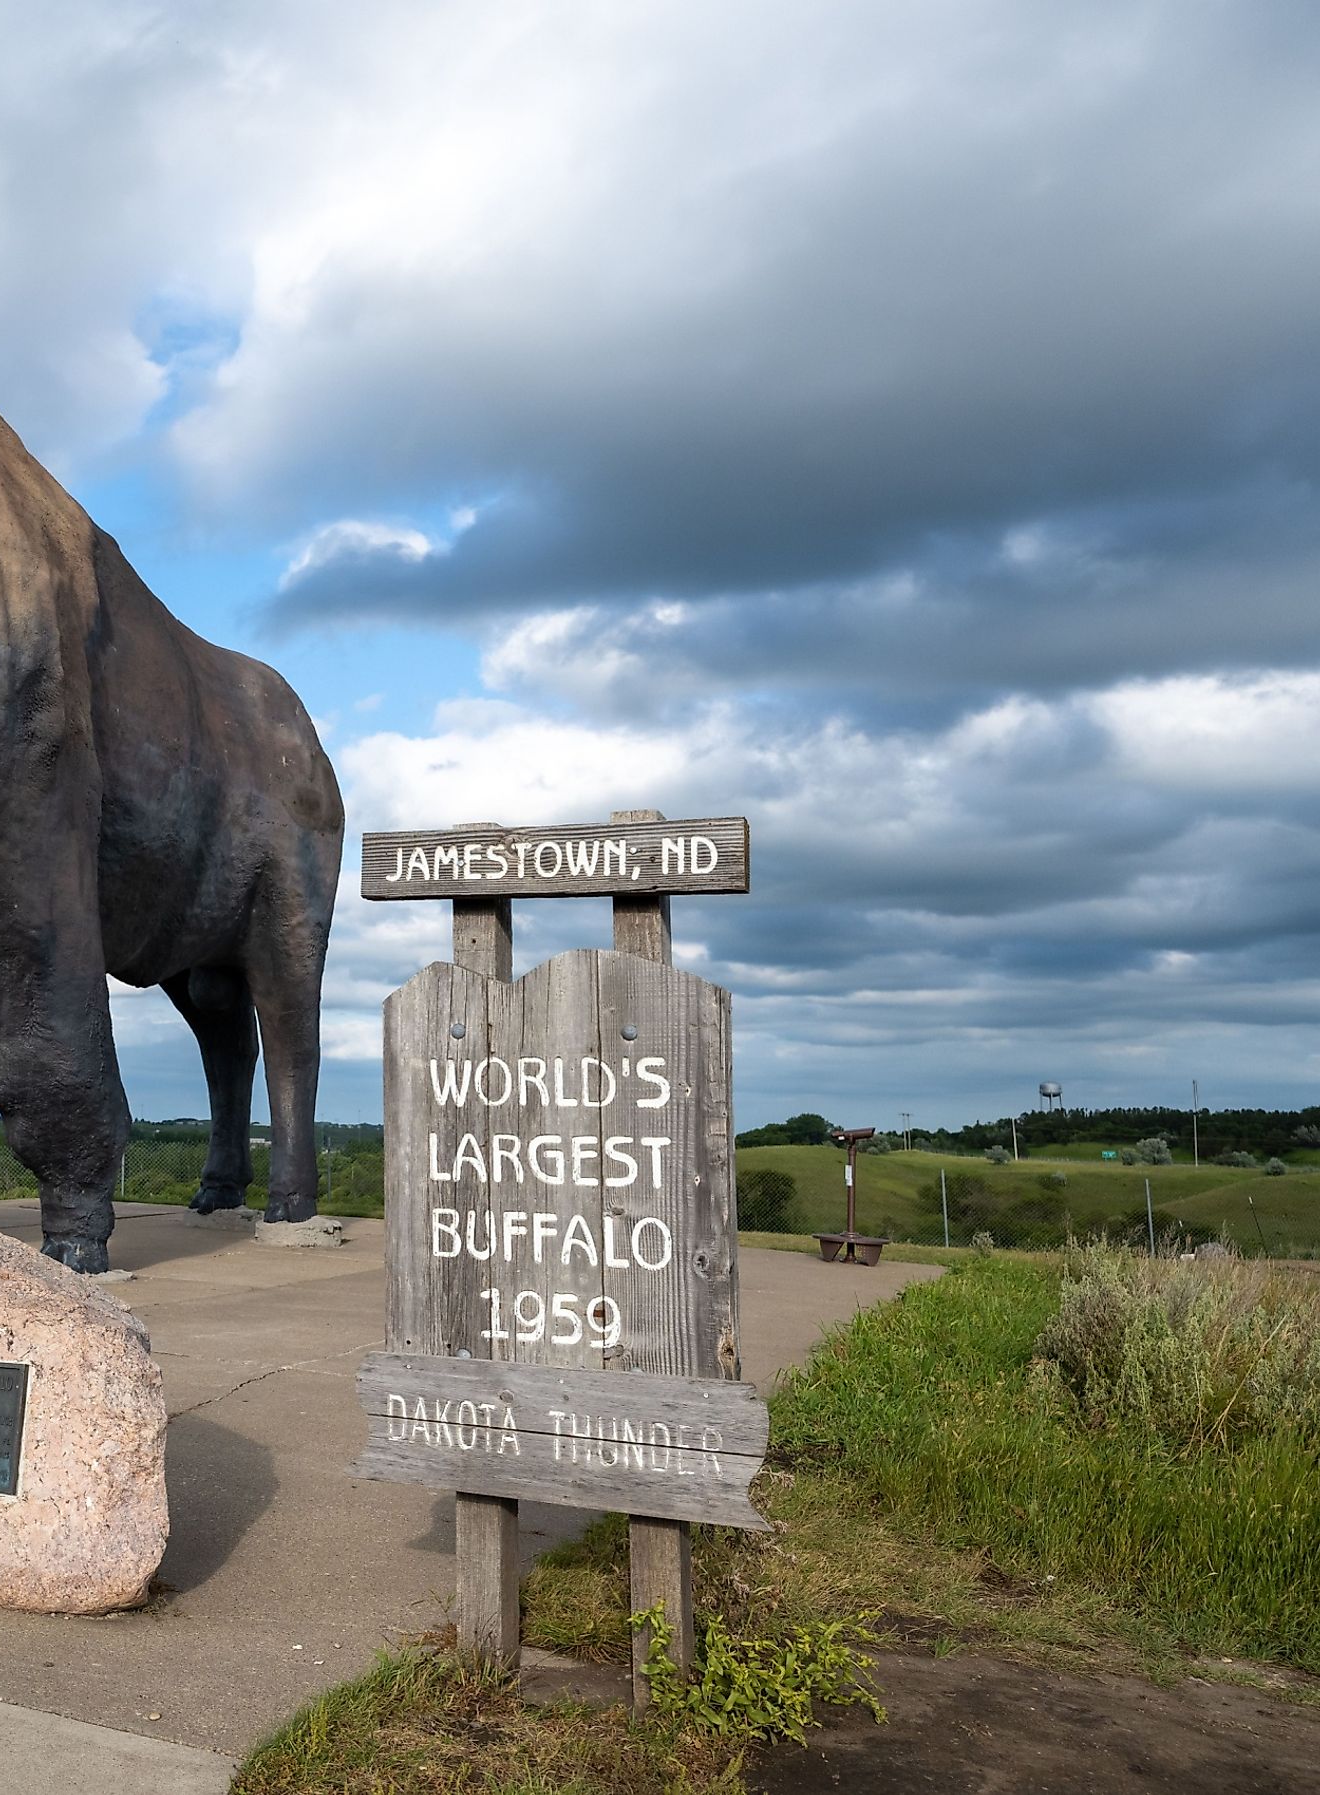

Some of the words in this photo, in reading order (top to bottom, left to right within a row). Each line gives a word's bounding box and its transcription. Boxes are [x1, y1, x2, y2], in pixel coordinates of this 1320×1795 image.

[661, 836, 719, 876] ND
[429, 1056, 672, 1110] WORLD'S
[428, 1132, 672, 1190] LARGEST
[431, 1208, 673, 1271] BUFFALO
[479, 1287, 622, 1349] 1959
[386, 1393, 521, 1456] DAKOTA
[548, 1410, 724, 1478] THUNDER
